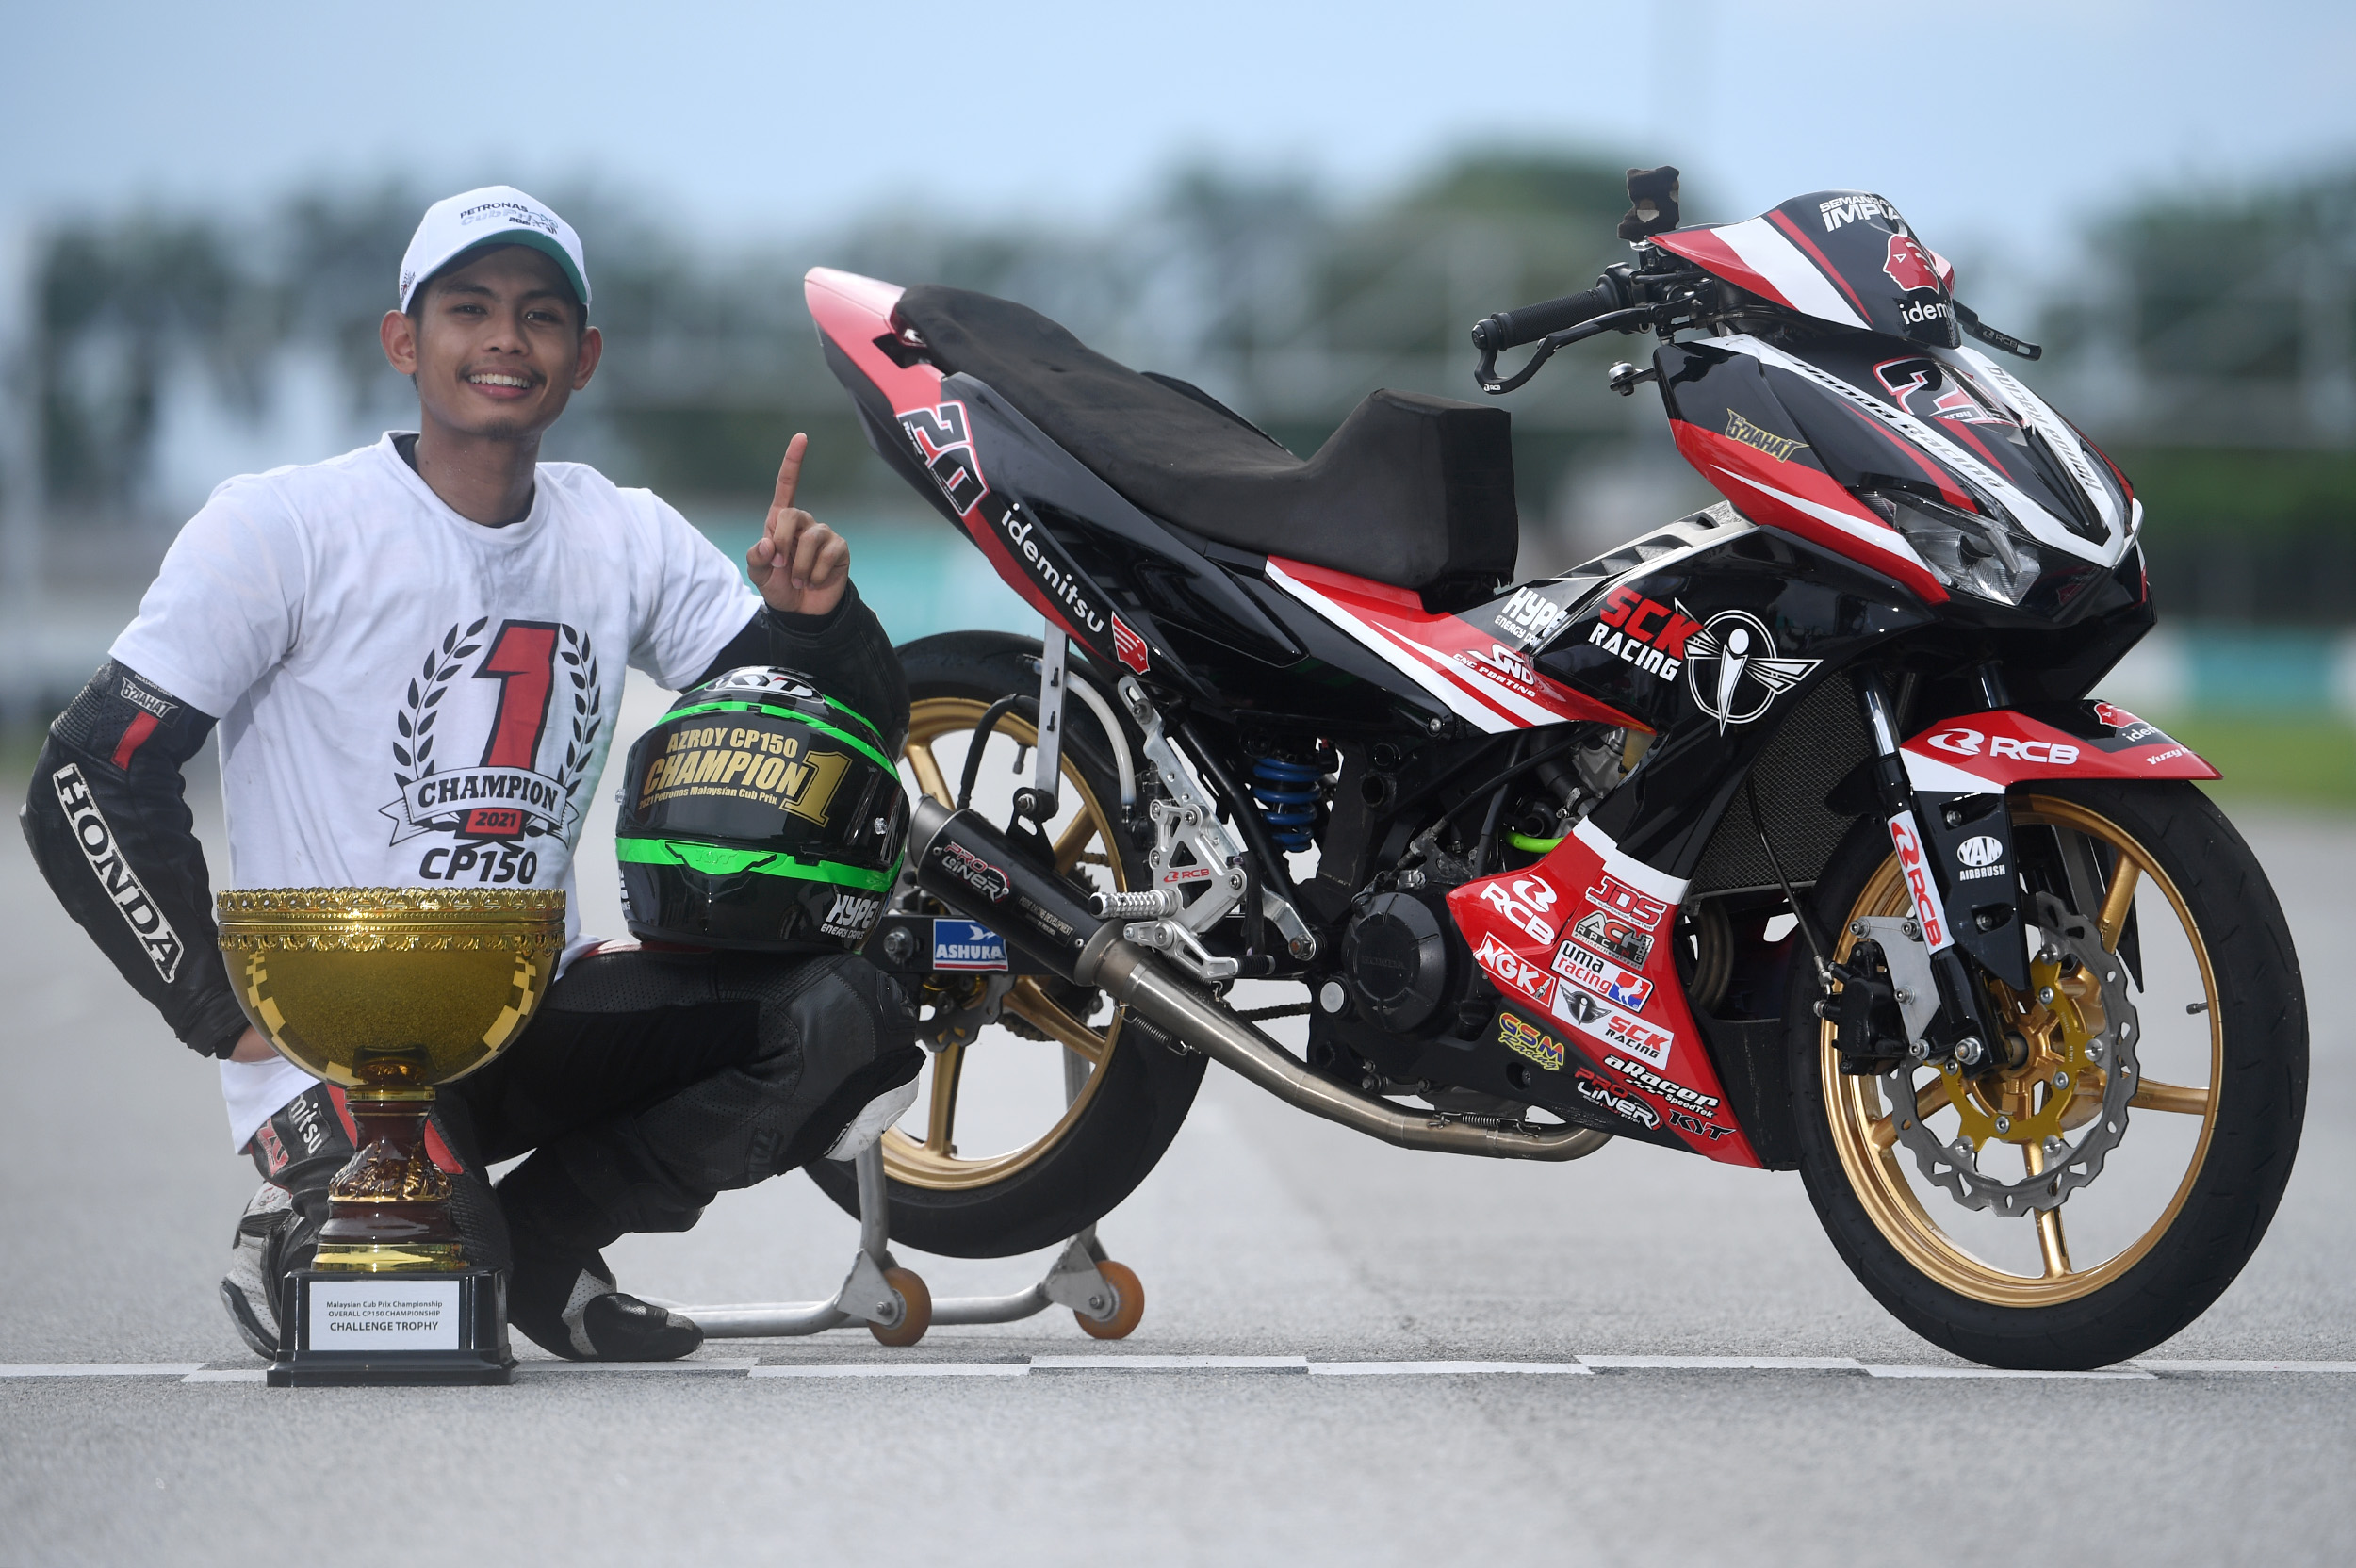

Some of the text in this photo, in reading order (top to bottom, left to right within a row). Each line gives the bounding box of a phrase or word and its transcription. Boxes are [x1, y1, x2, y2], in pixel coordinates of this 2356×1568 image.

[460, 202, 529, 219] PETRONAS
[1995, 334, 2018, 349] RCB
[1792, 362, 2005, 488] Honda Racing
[1001, 502, 1105, 634] idemitsu
[1494, 614, 1527, 639] ENERGY
[1501, 586, 1569, 638] HYPE
[1599, 585, 1707, 662] SCK
[1587, 622, 1683, 683] RACING
[1452, 653, 1536, 698] CNC PORTING
[471, 618, 562, 771] 1
[666, 727, 799, 759] AZROY CP150
[1989, 735, 2080, 765] RCB
[417, 775, 558, 813] CHAMPION
[643, 749, 853, 828] CHAMPION 1
[655, 788, 689, 802] Petronas
[690, 786, 737, 797] Malaysian
[739, 788, 758, 801] Cub
[759, 792, 778, 806] Prix
[474, 810, 517, 828] 2021
[57, 766, 183, 980] HONDA
[418, 847, 538, 885] CP150
[944, 841, 989, 874] PRO
[1182, 868, 1210, 878] RCB
[1959, 864, 2006, 881] AIRBRUSH
[826, 893, 880, 929] HYPE
[1480, 881, 1556, 946] RCB
[1587, 877, 1666, 927] JDS
[1906, 866, 1943, 947] RCB
[936, 944, 1006, 959] ASHUKA
[1562, 942, 1605, 974] uma
[1577, 924, 1644, 963] RACING
[1474, 938, 1540, 995] NGK
[1557, 956, 1612, 995] racing
[1498, 1032, 1560, 1070] Racing
[1499, 1012, 1564, 1066] GSM
[1604, 1028, 1660, 1059] RACING
[1608, 1015, 1672, 1052] SCK
[1574, 1067, 1629, 1099] PRO
[1664, 1093, 1717, 1119] SpeedTek
[1668, 1108, 1737, 1141] KYT
[326, 1301, 361, 1310] Malaysian
[392, 1300, 443, 1309] Championship
[330, 1321, 438, 1331] CHALLENGE TROPHY
